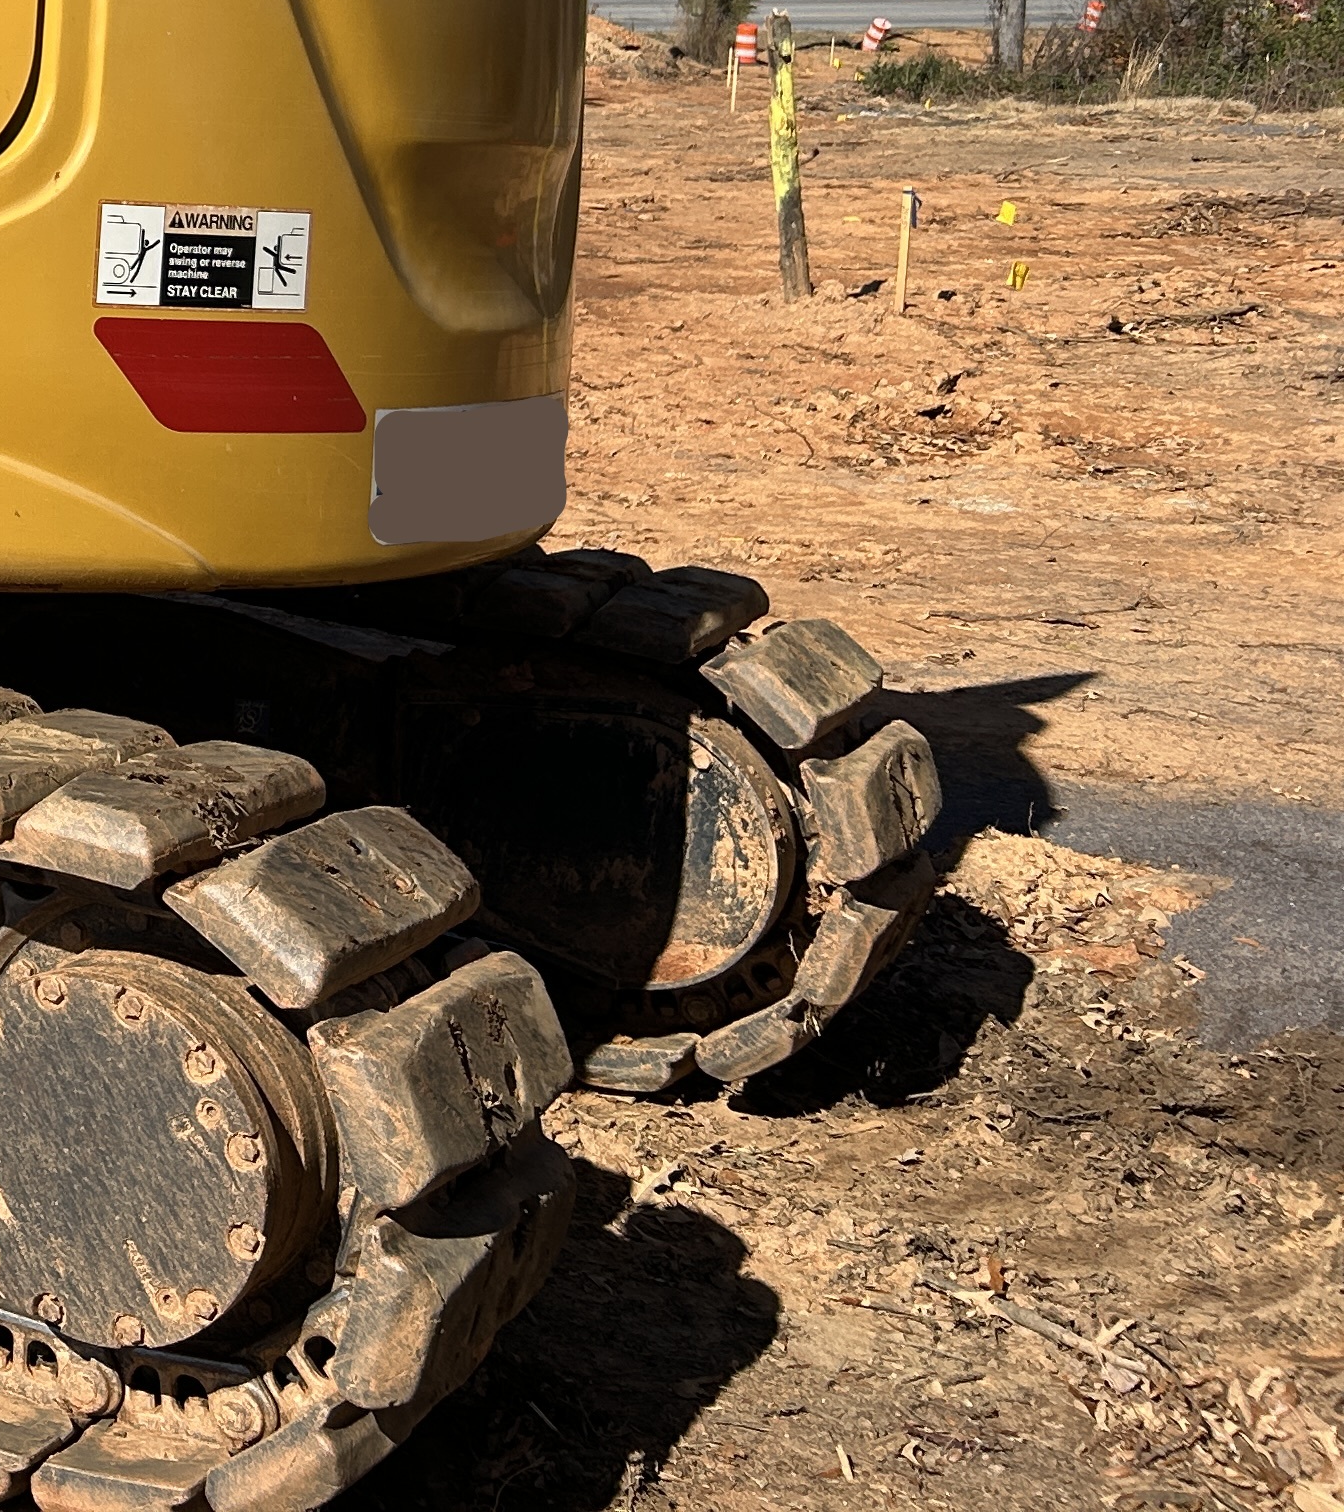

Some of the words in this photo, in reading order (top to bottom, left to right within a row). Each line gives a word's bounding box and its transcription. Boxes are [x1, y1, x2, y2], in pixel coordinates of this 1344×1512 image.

[185, 213, 253, 231] WARNING
[169, 242, 212, 256] Operator
[213, 246, 233, 258] may
[199, 259, 211, 267] or
[212, 259, 246, 269] reverse
[168, 268, 209, 280] machine
[167, 284, 198, 298] STAY
[199, 286, 238, 299] CLEAR
